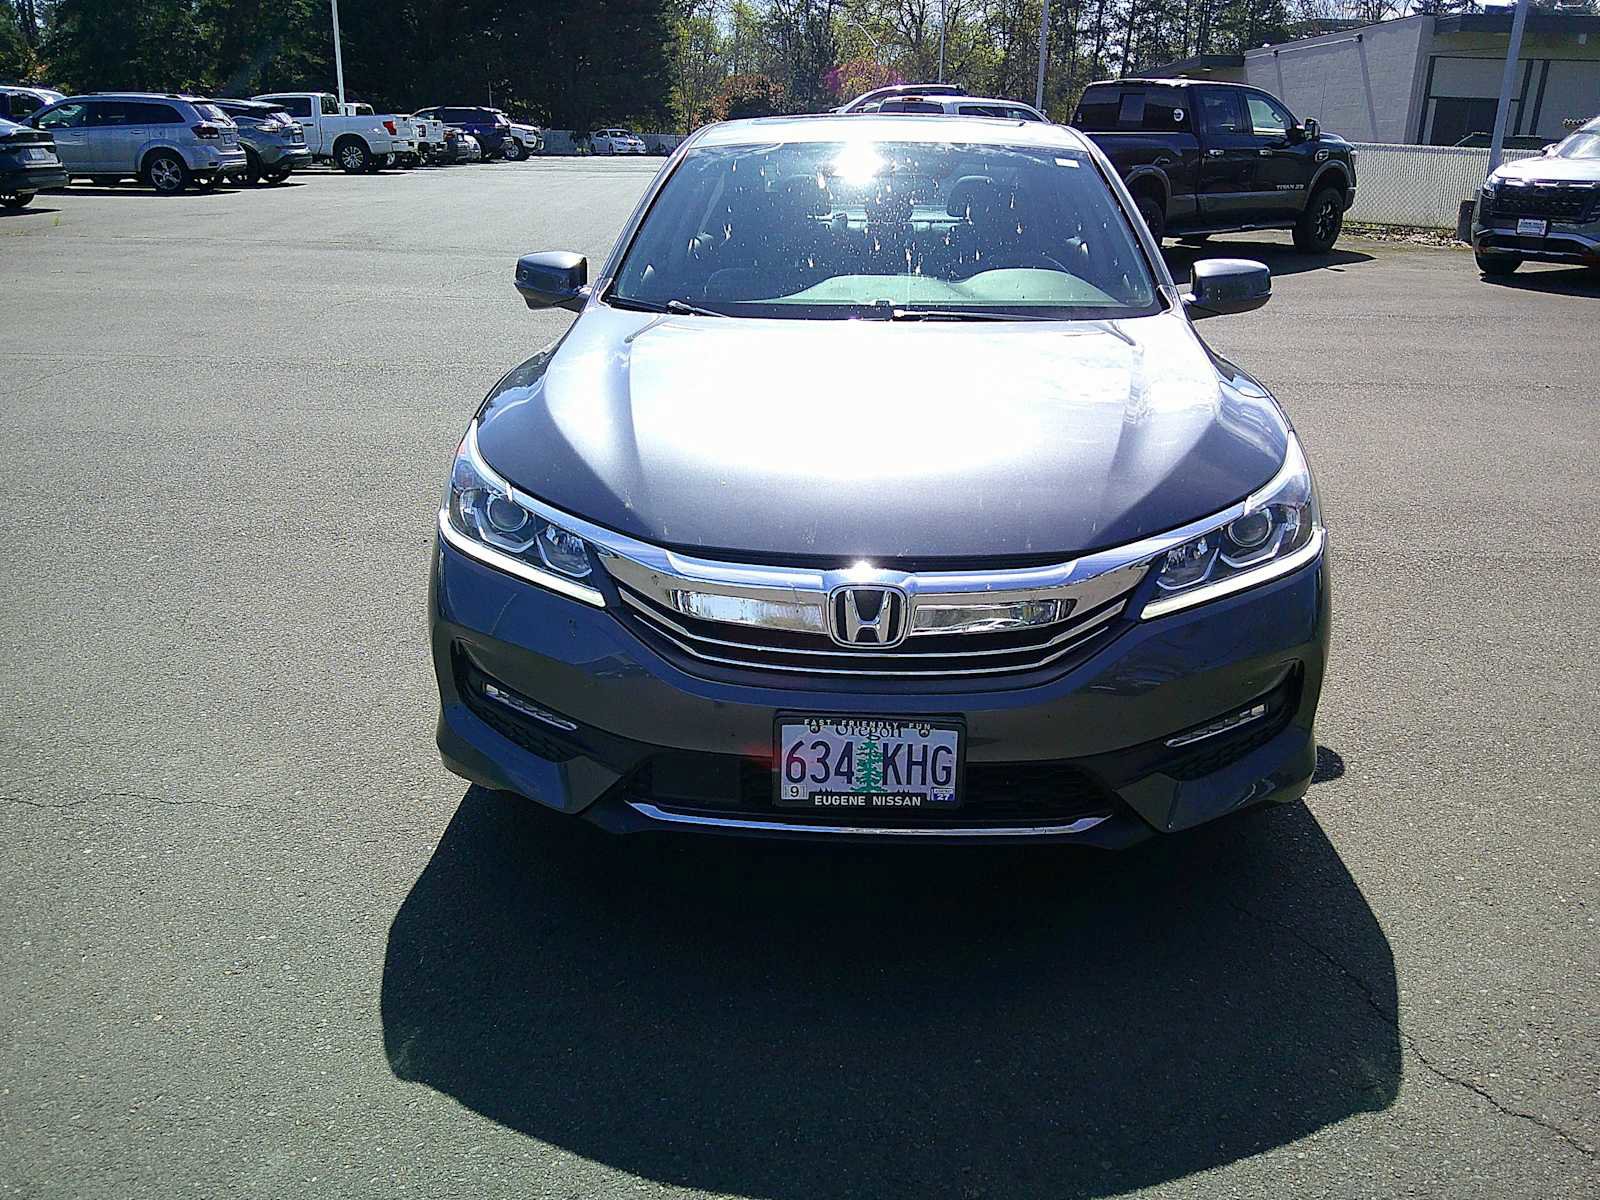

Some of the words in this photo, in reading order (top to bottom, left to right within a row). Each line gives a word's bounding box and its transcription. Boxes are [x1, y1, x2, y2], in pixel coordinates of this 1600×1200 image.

[836, 725, 904, 741] Oregon
[786, 740, 854, 784] 634
[882, 743, 953, 786] KHG
[790, 785, 800, 798] 9
[815, 796, 866, 806] EUGENE
[872, 796, 921, 807] NISSAN
